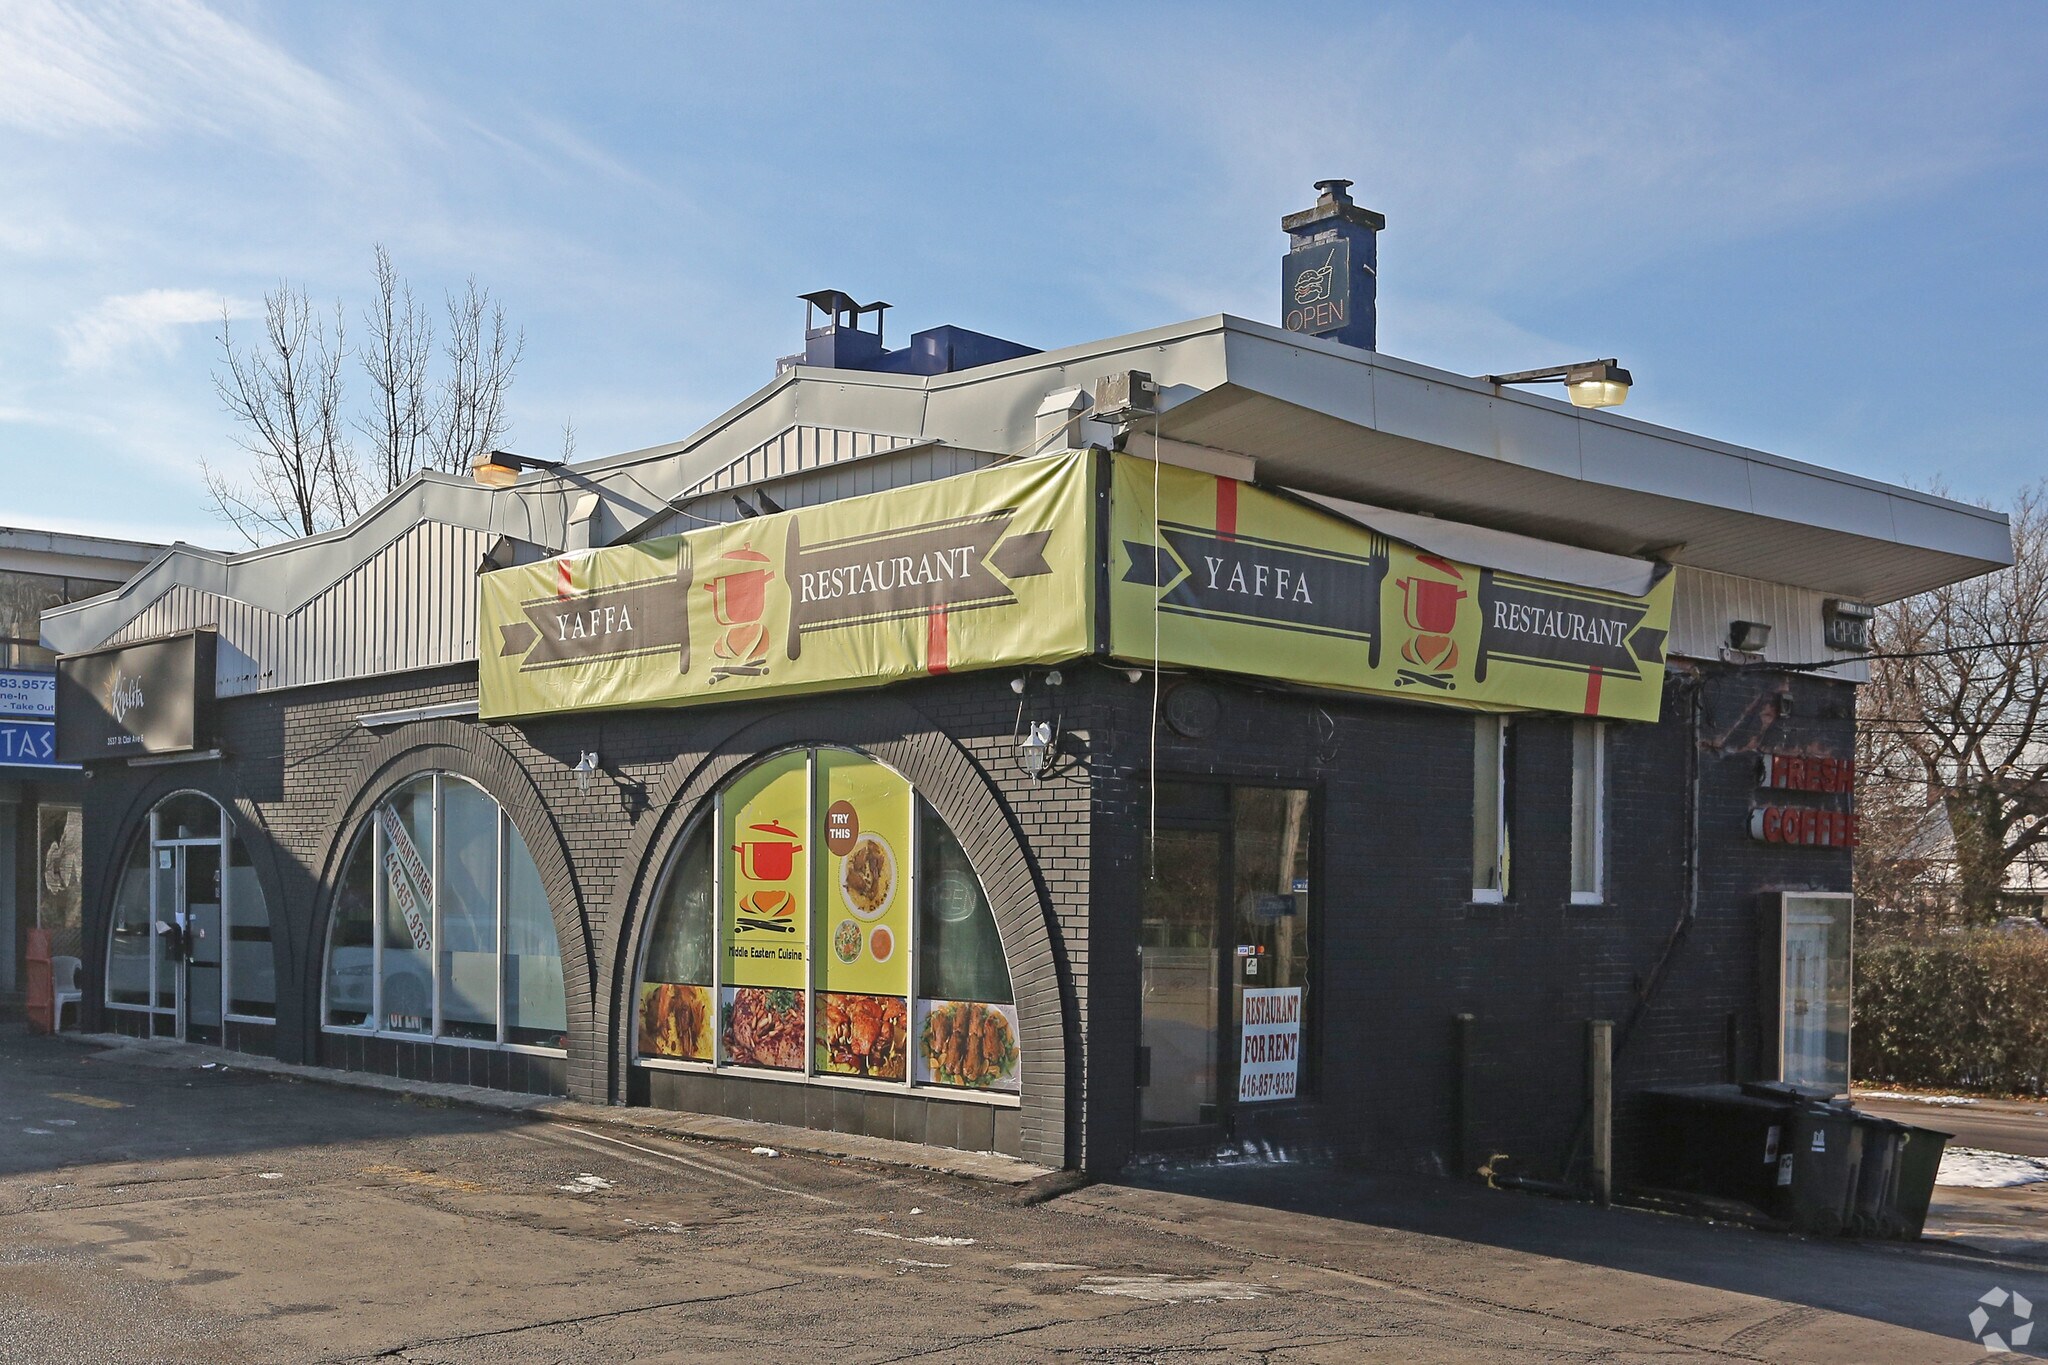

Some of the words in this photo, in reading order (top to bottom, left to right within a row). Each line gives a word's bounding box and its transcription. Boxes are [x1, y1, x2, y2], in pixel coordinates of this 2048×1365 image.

[1286, 299, 1345, 332] OPEN
[799, 545, 975, 603] RESTAURANT
[1204, 555, 1313, 605] YAFFA
[555, 604, 633, 641] YAFFA
[1493, 600, 1628, 648] RESTAURANT
[1833, 619, 1869, 647] OPEN
[10, 702, 34, 711] Take
[36, 703, 55, 712] Out
[1771, 754, 1855, 793] FRESH
[829, 828, 851, 839] THIS
[831, 813, 850, 824] TRY
[1763, 806, 1861, 847] COFFEE
[384, 807, 415, 867] RESTAURANT
[412, 856, 424, 886] FOR
[728, 946, 749, 958] Middle
[750, 946, 776, 959] Eastern
[778, 948, 803, 961] Cuisine
[1245, 995, 1299, 1026] RESTAURANT
[1244, 1034, 1266, 1064] FOR
[1267, 1033, 1298, 1062] RENT
[1241, 1071, 1295, 1098] 416-857-9333
